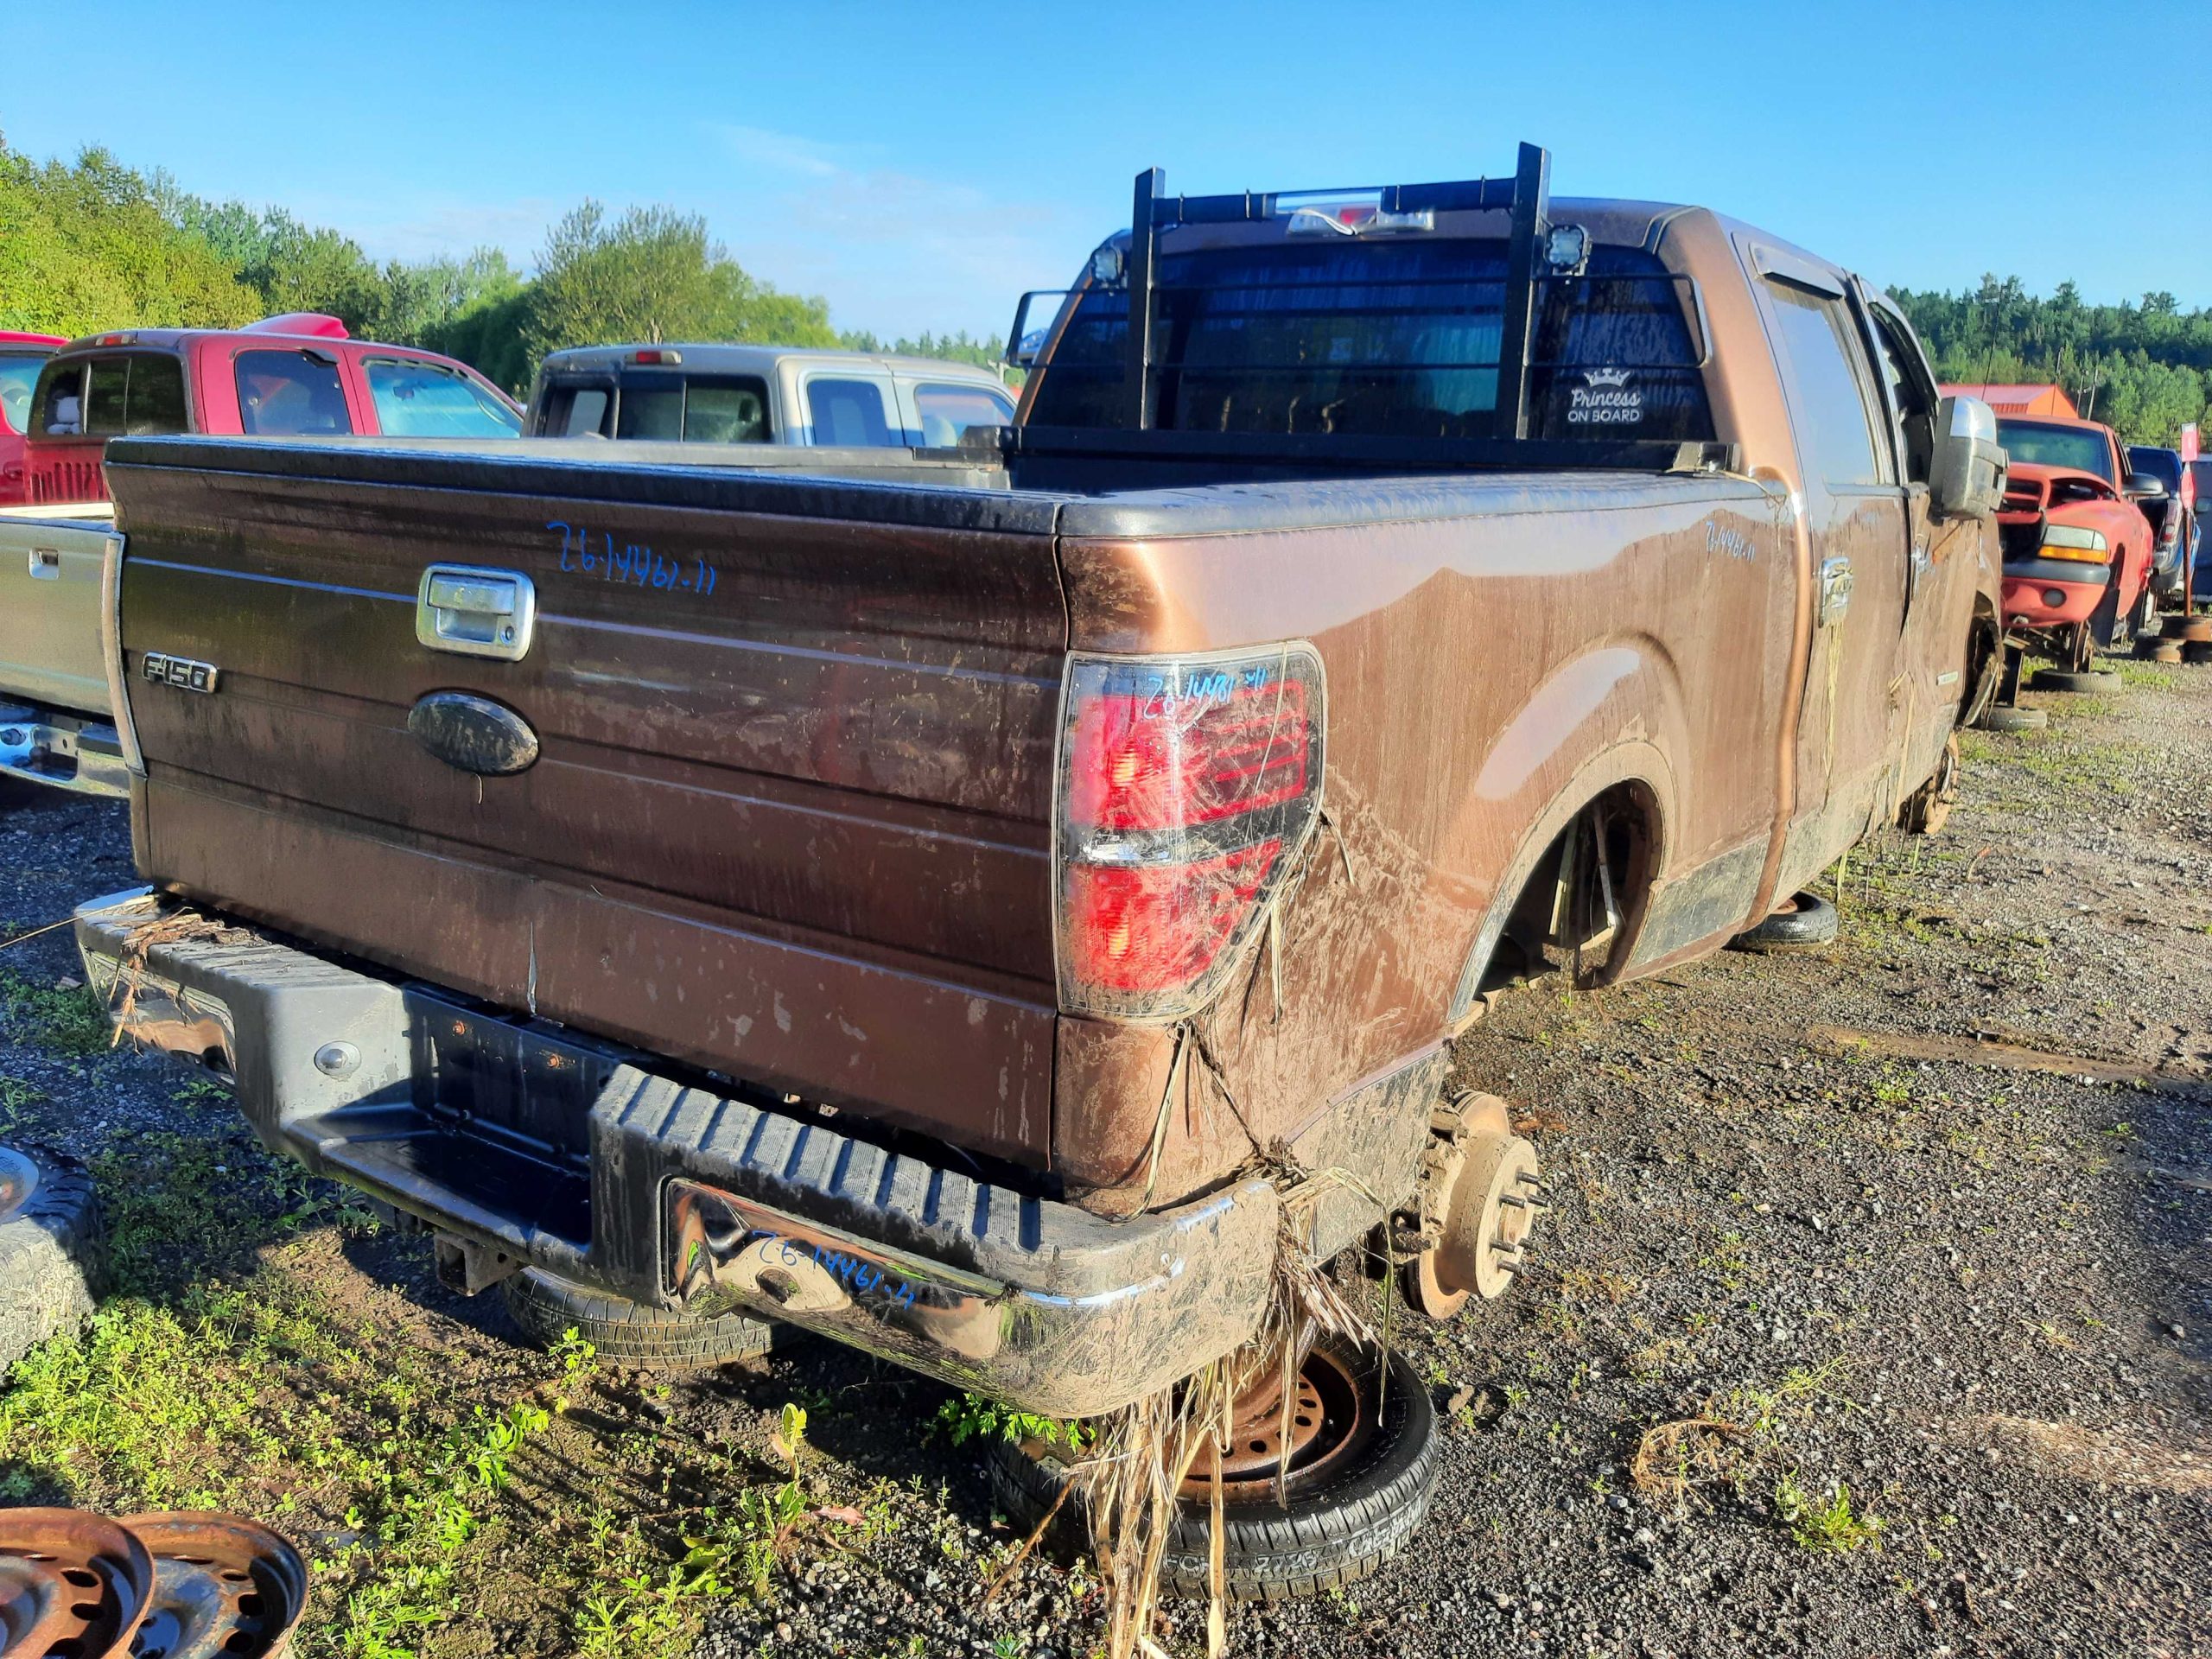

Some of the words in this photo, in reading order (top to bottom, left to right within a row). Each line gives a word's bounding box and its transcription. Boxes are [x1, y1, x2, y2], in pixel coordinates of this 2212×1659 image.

[1571, 388, 1641, 408] Princess
[1567, 410, 1588, 423] ON
[1592, 409, 1640, 423] BOARD
